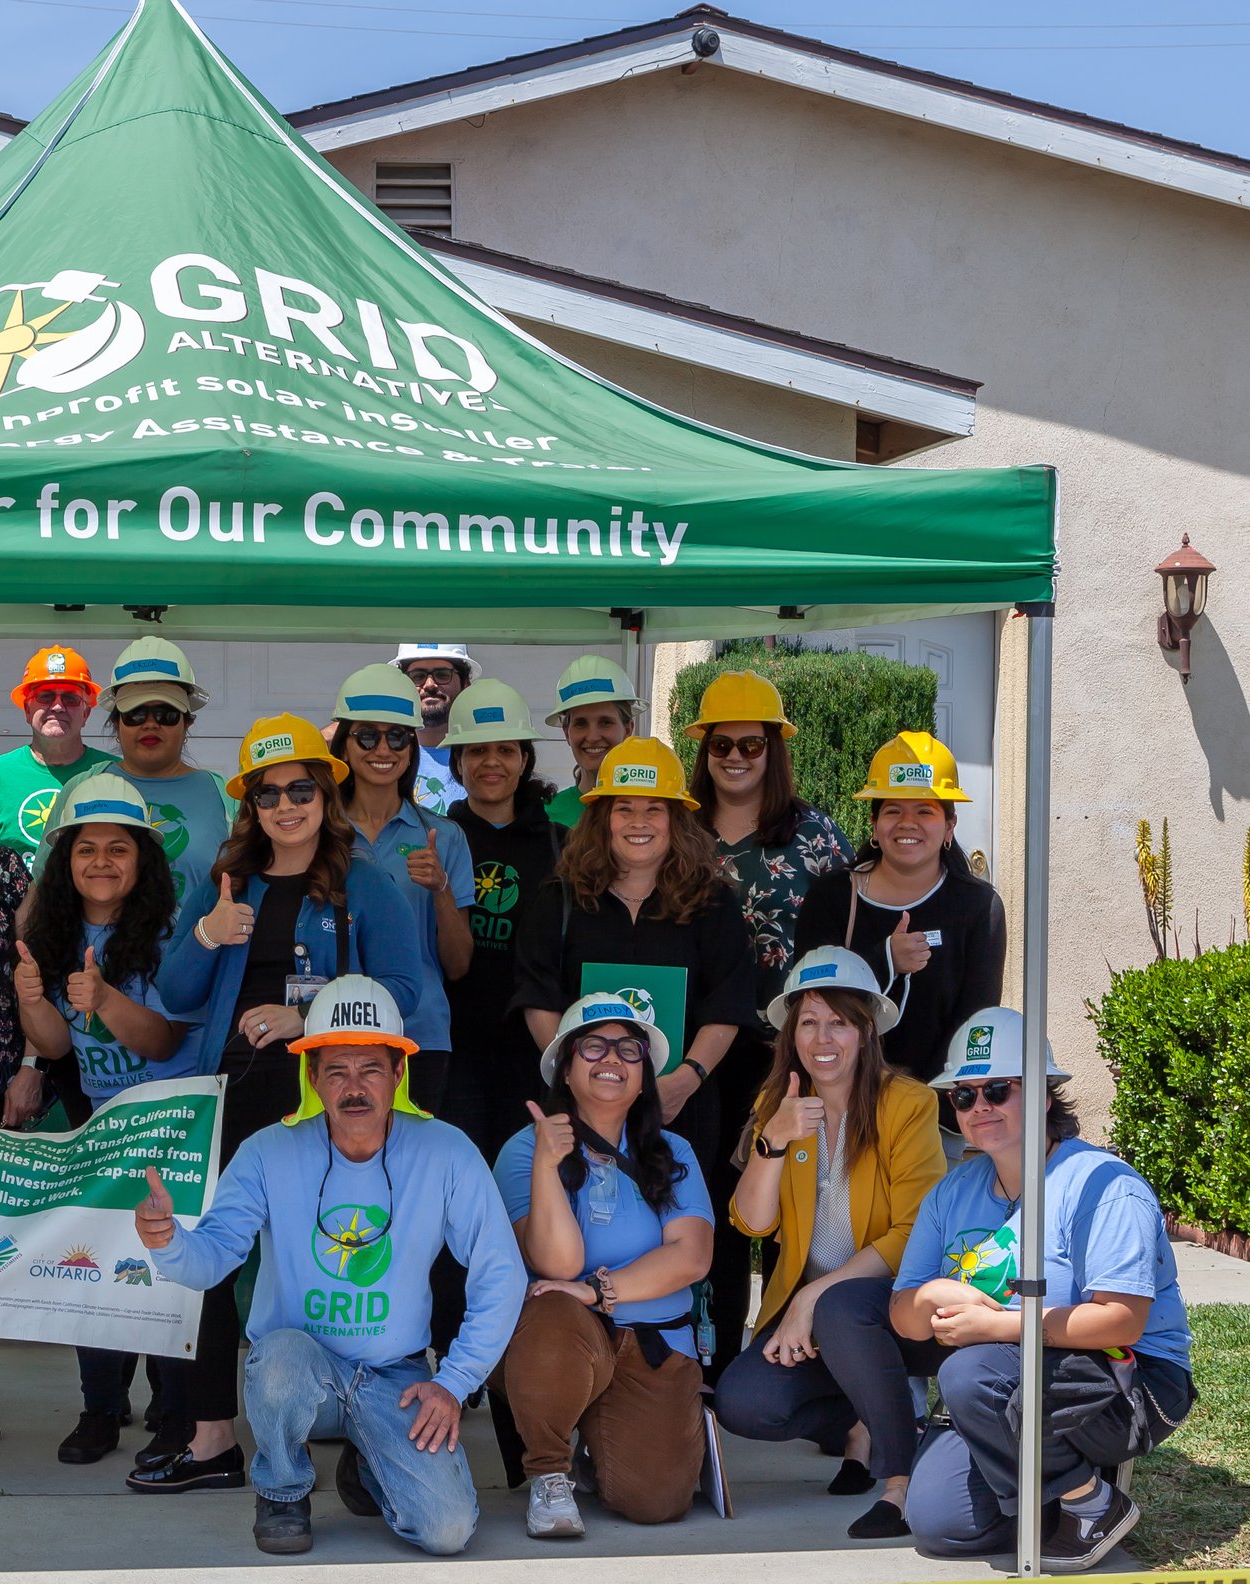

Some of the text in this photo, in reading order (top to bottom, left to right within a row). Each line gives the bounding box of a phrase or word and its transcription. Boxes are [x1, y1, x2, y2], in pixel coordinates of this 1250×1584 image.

[150, 253, 499, 393] GRID
[132, 415, 424, 456] Assistance
[443, 450, 485, 462] &
[36, 483, 138, 540] for
[158, 486, 283, 543] Our
[303, 491, 689, 566] Community
[265, 737, 292, 750] GRID
[630, 768, 656, 780] GRID
[906, 767, 933, 779] GRID
[470, 913, 513, 940] RID
[475, 939, 509, 951] NATIVES
[330, 1001, 381, 1028] ANGEL
[967, 1046, 990, 1056] GRID
[109, 1117, 127, 1131] by
[131, 1106, 196, 1127] California
[86, 1125, 187, 1152] Transformative
[32, 1160, 91, 1176] program
[94, 1150, 120, 1164] with
[123, 1146, 164, 1159] funds
[167, 1147, 203, 1162] from
[32, 1198, 45, 1206] at
[48, 1186, 83, 1203] Work.
[30, 1265, 101, 1283] ONTARIO
[304, 1289, 390, 1324] GRID
[303, 1323, 386, 1337] ALTERNATIVES
